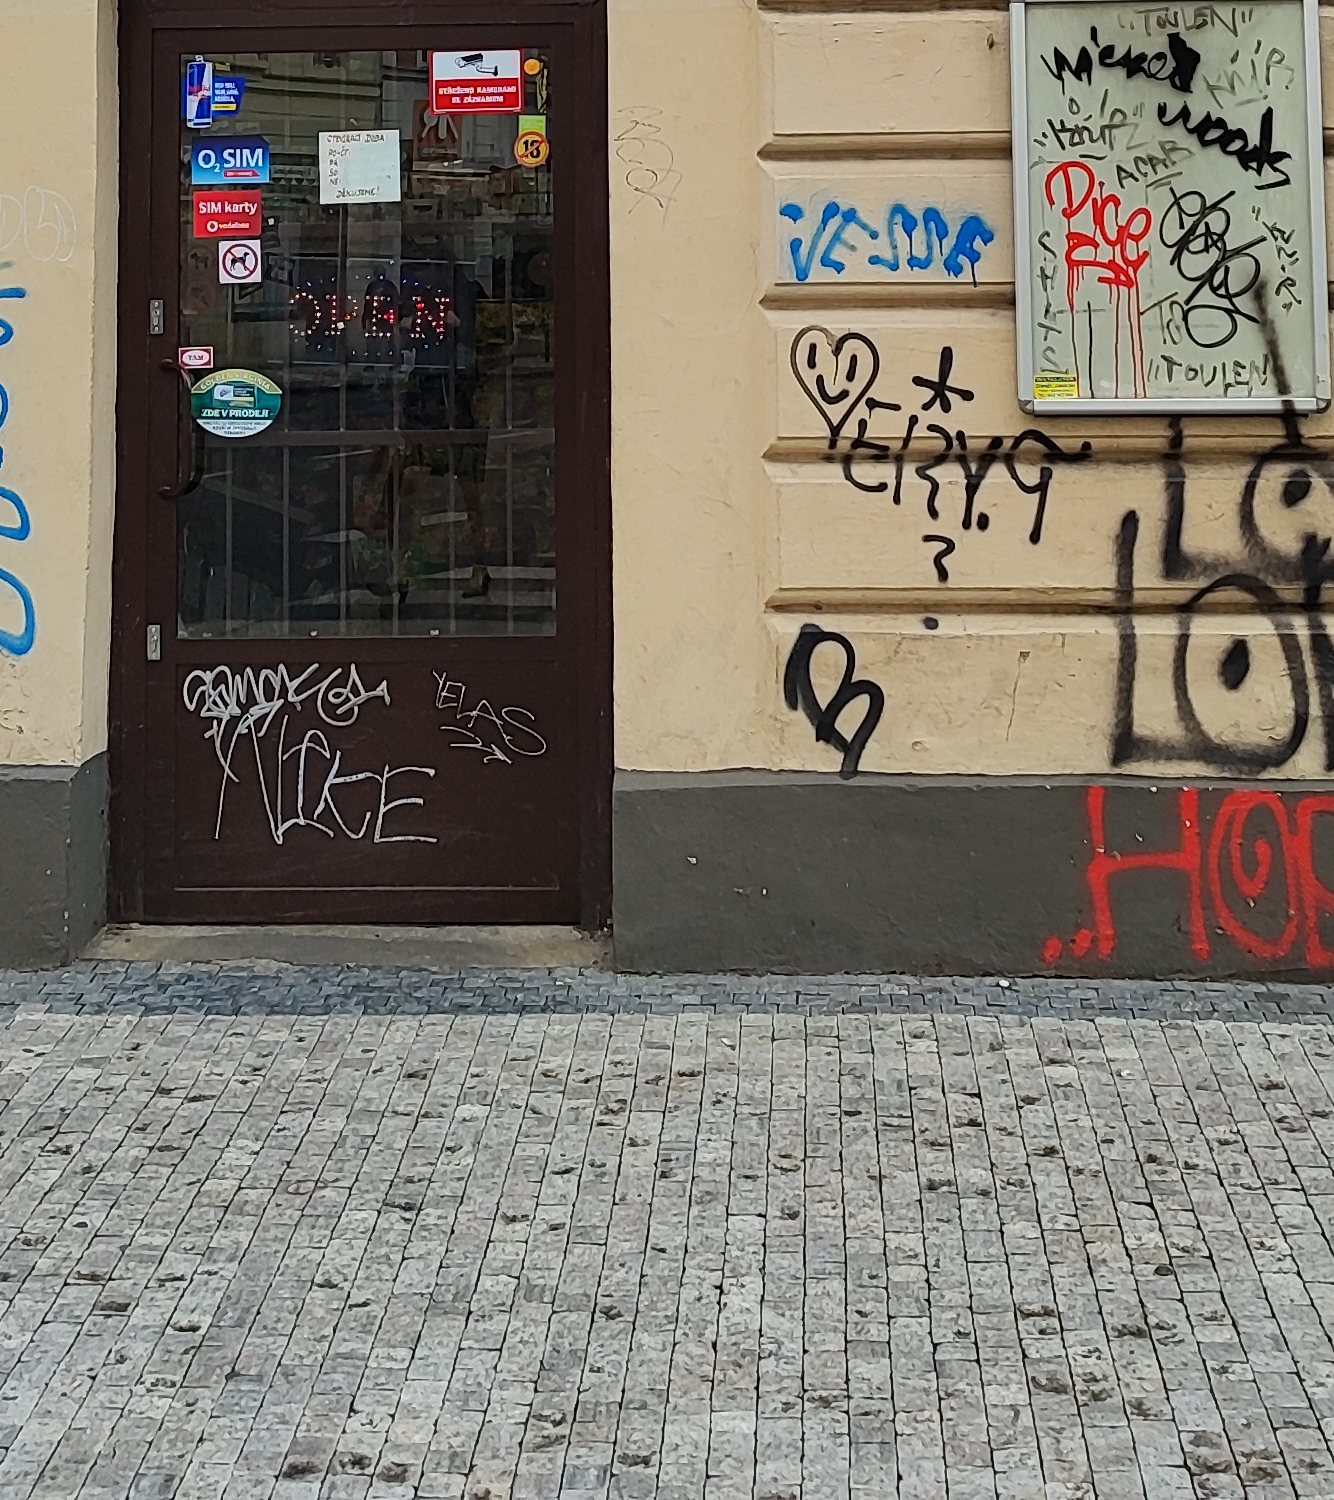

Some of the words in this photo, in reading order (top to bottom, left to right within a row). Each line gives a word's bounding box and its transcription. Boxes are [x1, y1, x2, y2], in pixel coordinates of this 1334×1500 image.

[222, 148, 263, 169] SIM
[522, 139, 541, 159] 18
[198, 201, 222, 214] SIM
[223, 200, 258, 216] karty
